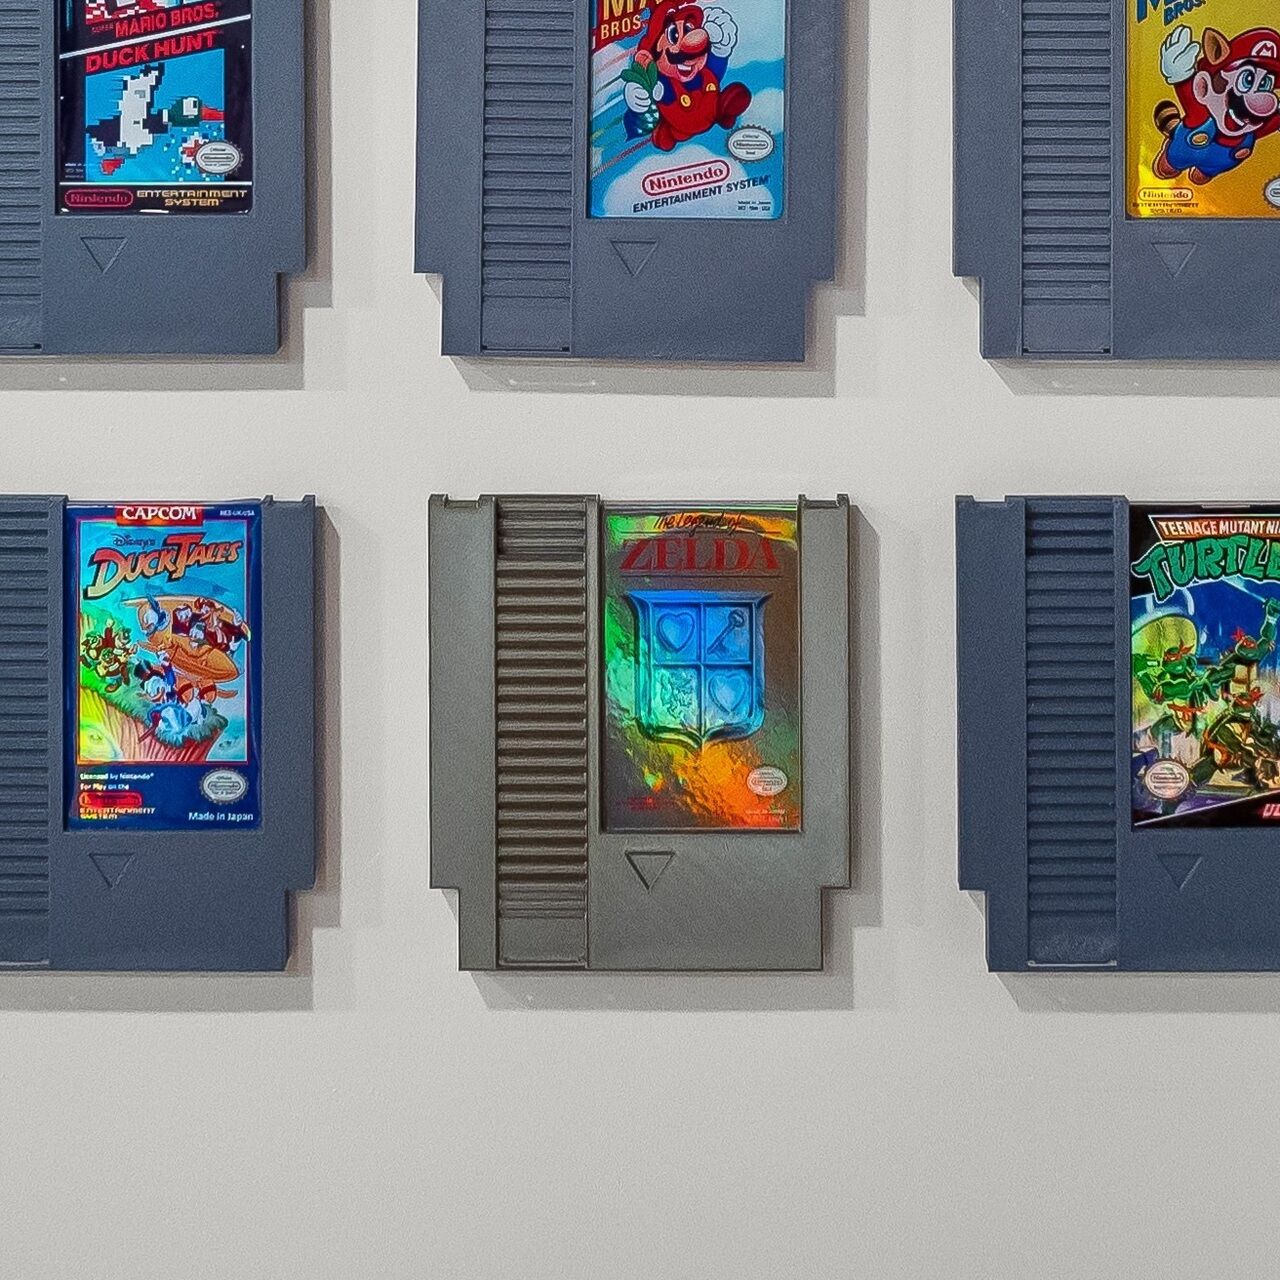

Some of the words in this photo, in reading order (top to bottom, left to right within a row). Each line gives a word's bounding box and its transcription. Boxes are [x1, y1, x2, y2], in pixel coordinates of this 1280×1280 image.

[115, 12, 167, 38] MARIO
[85, 42, 150, 73] DUCK
[154, 30, 217, 58] HUNT
[648, 166, 724, 192] Nintendo
[136, 190, 247, 198] ENTERTAINMENT
[165, 198, 219, 206] SYSTEM
[632, 185, 723, 214] ENTERTAINMENT
[726, 175, 769, 192] SYSTEM
[122, 507, 197, 520] CAPCOM
[1158, 520, 1218, 536] TEENAGE
[1219, 520, 1265, 535] MUTANT
[620, 538, 780, 570] ZELDA
[188, 812, 214, 820] Made
[216, 812, 226, 820] in
[227, 812, 254, 822] Japan
